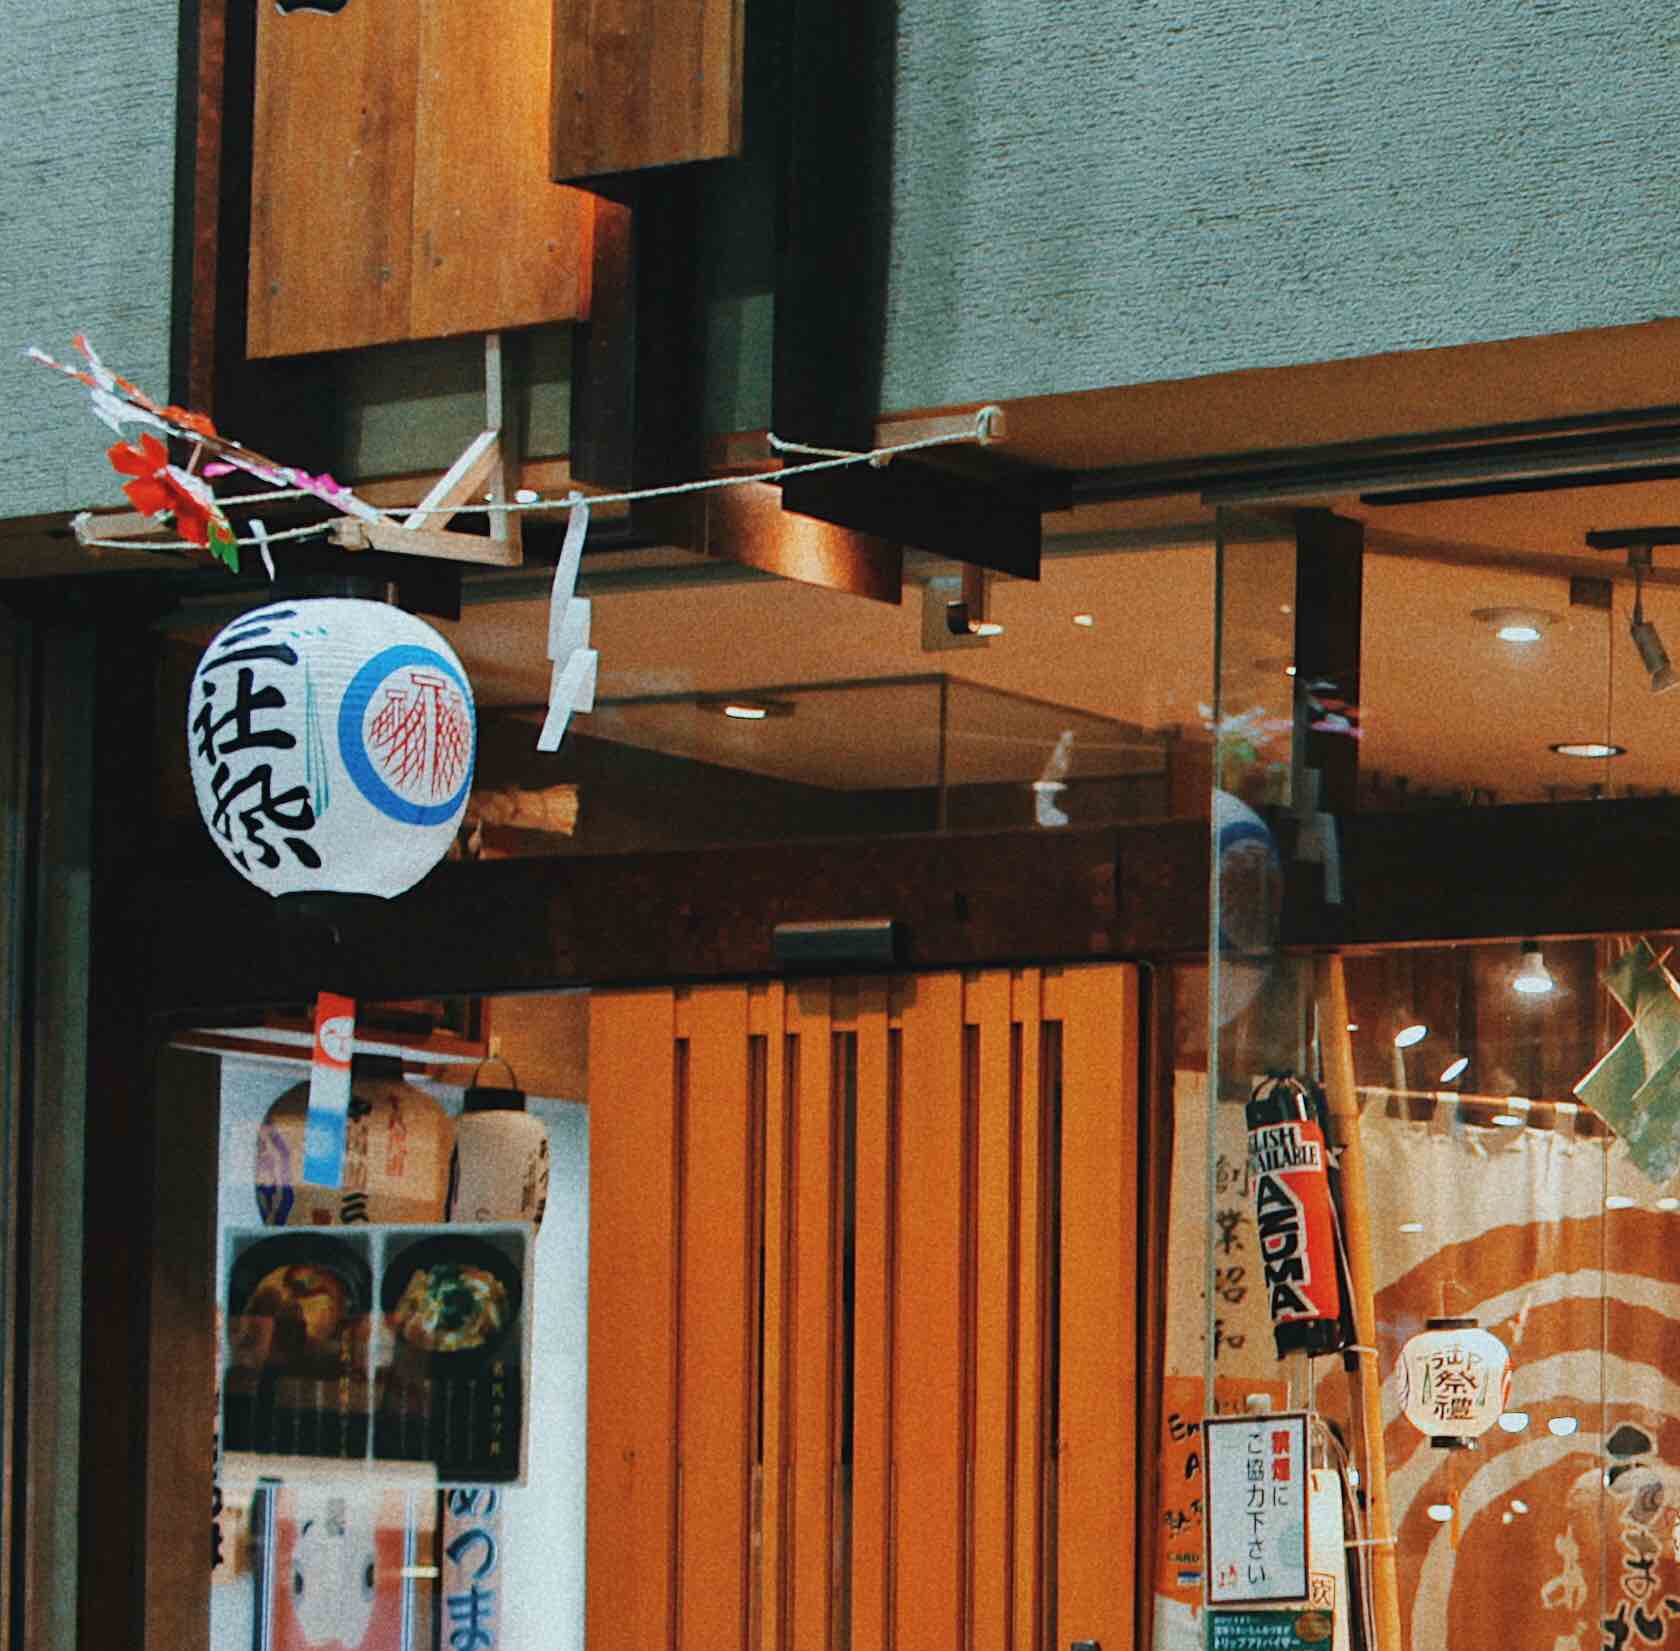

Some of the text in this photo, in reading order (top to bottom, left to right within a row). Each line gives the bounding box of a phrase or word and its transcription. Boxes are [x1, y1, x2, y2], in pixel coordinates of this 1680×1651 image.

[1247, 1434, 1266, 1584] ご協力下さい
